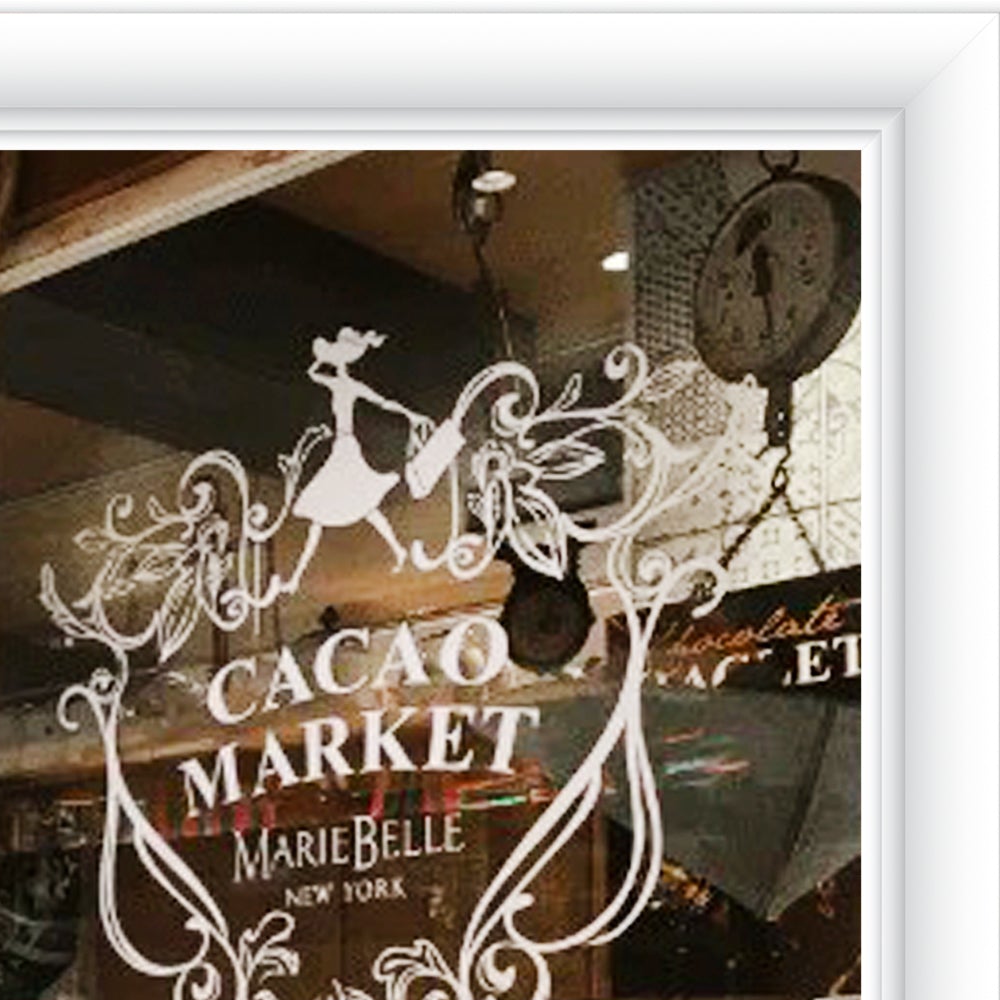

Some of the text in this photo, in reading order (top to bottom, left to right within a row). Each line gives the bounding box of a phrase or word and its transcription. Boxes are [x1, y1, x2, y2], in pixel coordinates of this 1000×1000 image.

[206, 615, 510, 725] CACAO
[177, 705, 541, 818] MARKET
[284, 876, 407, 908] NEW YORK
